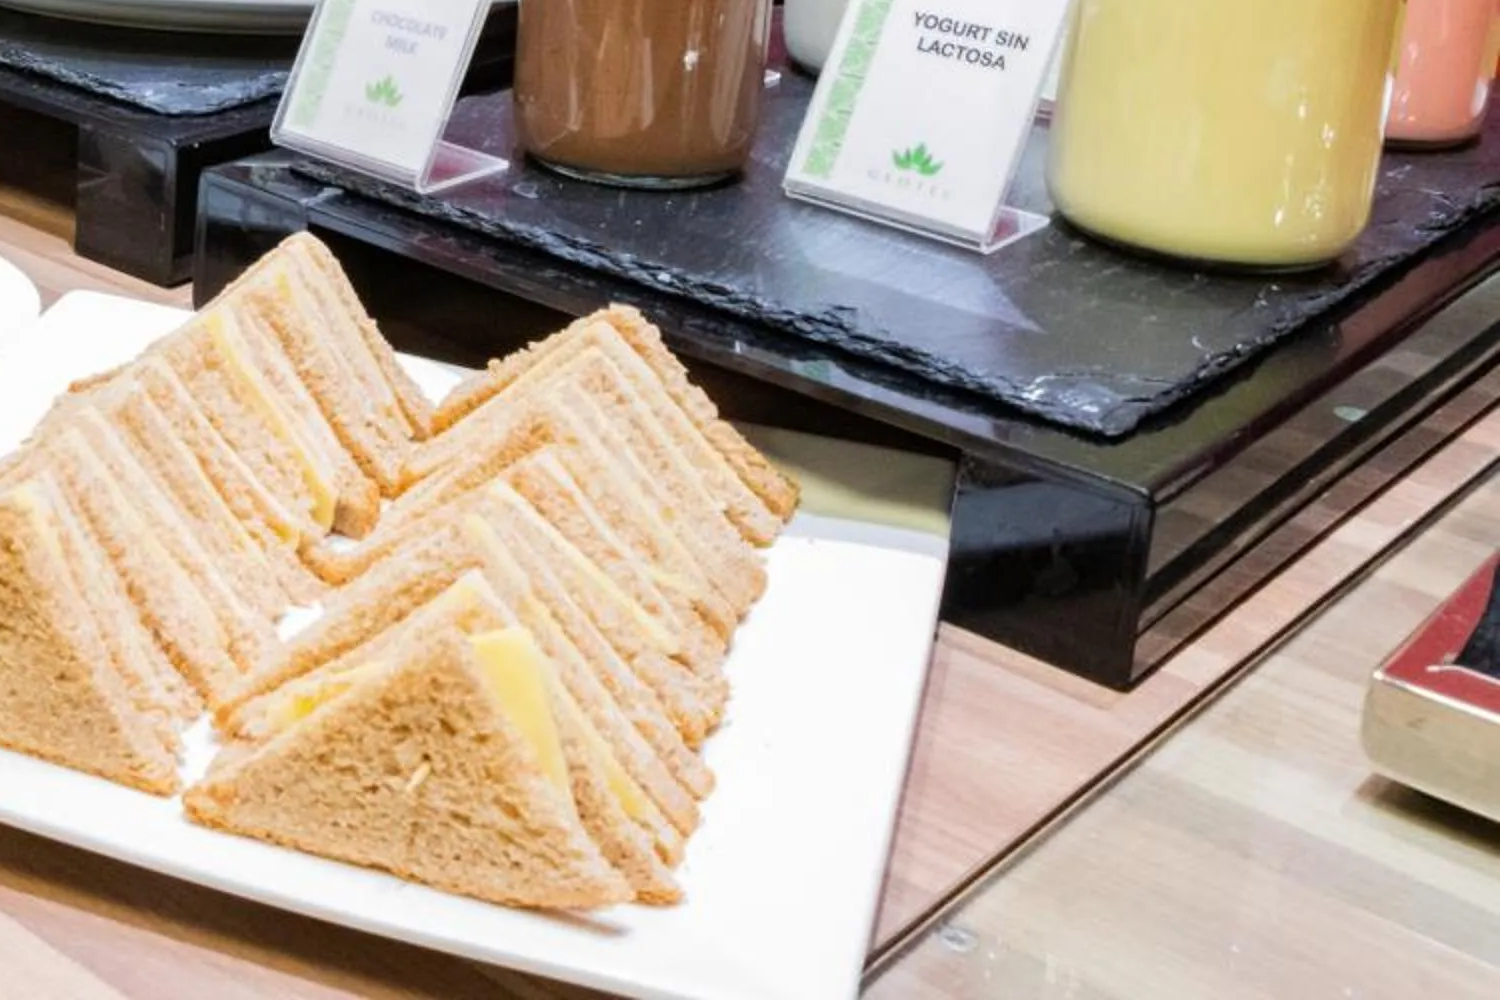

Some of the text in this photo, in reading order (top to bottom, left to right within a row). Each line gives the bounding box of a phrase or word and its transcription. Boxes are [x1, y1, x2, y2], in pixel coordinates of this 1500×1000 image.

[913, 11, 1030, 51] YOGURT SIN
[916, 36, 1007, 71] LACTOSA
